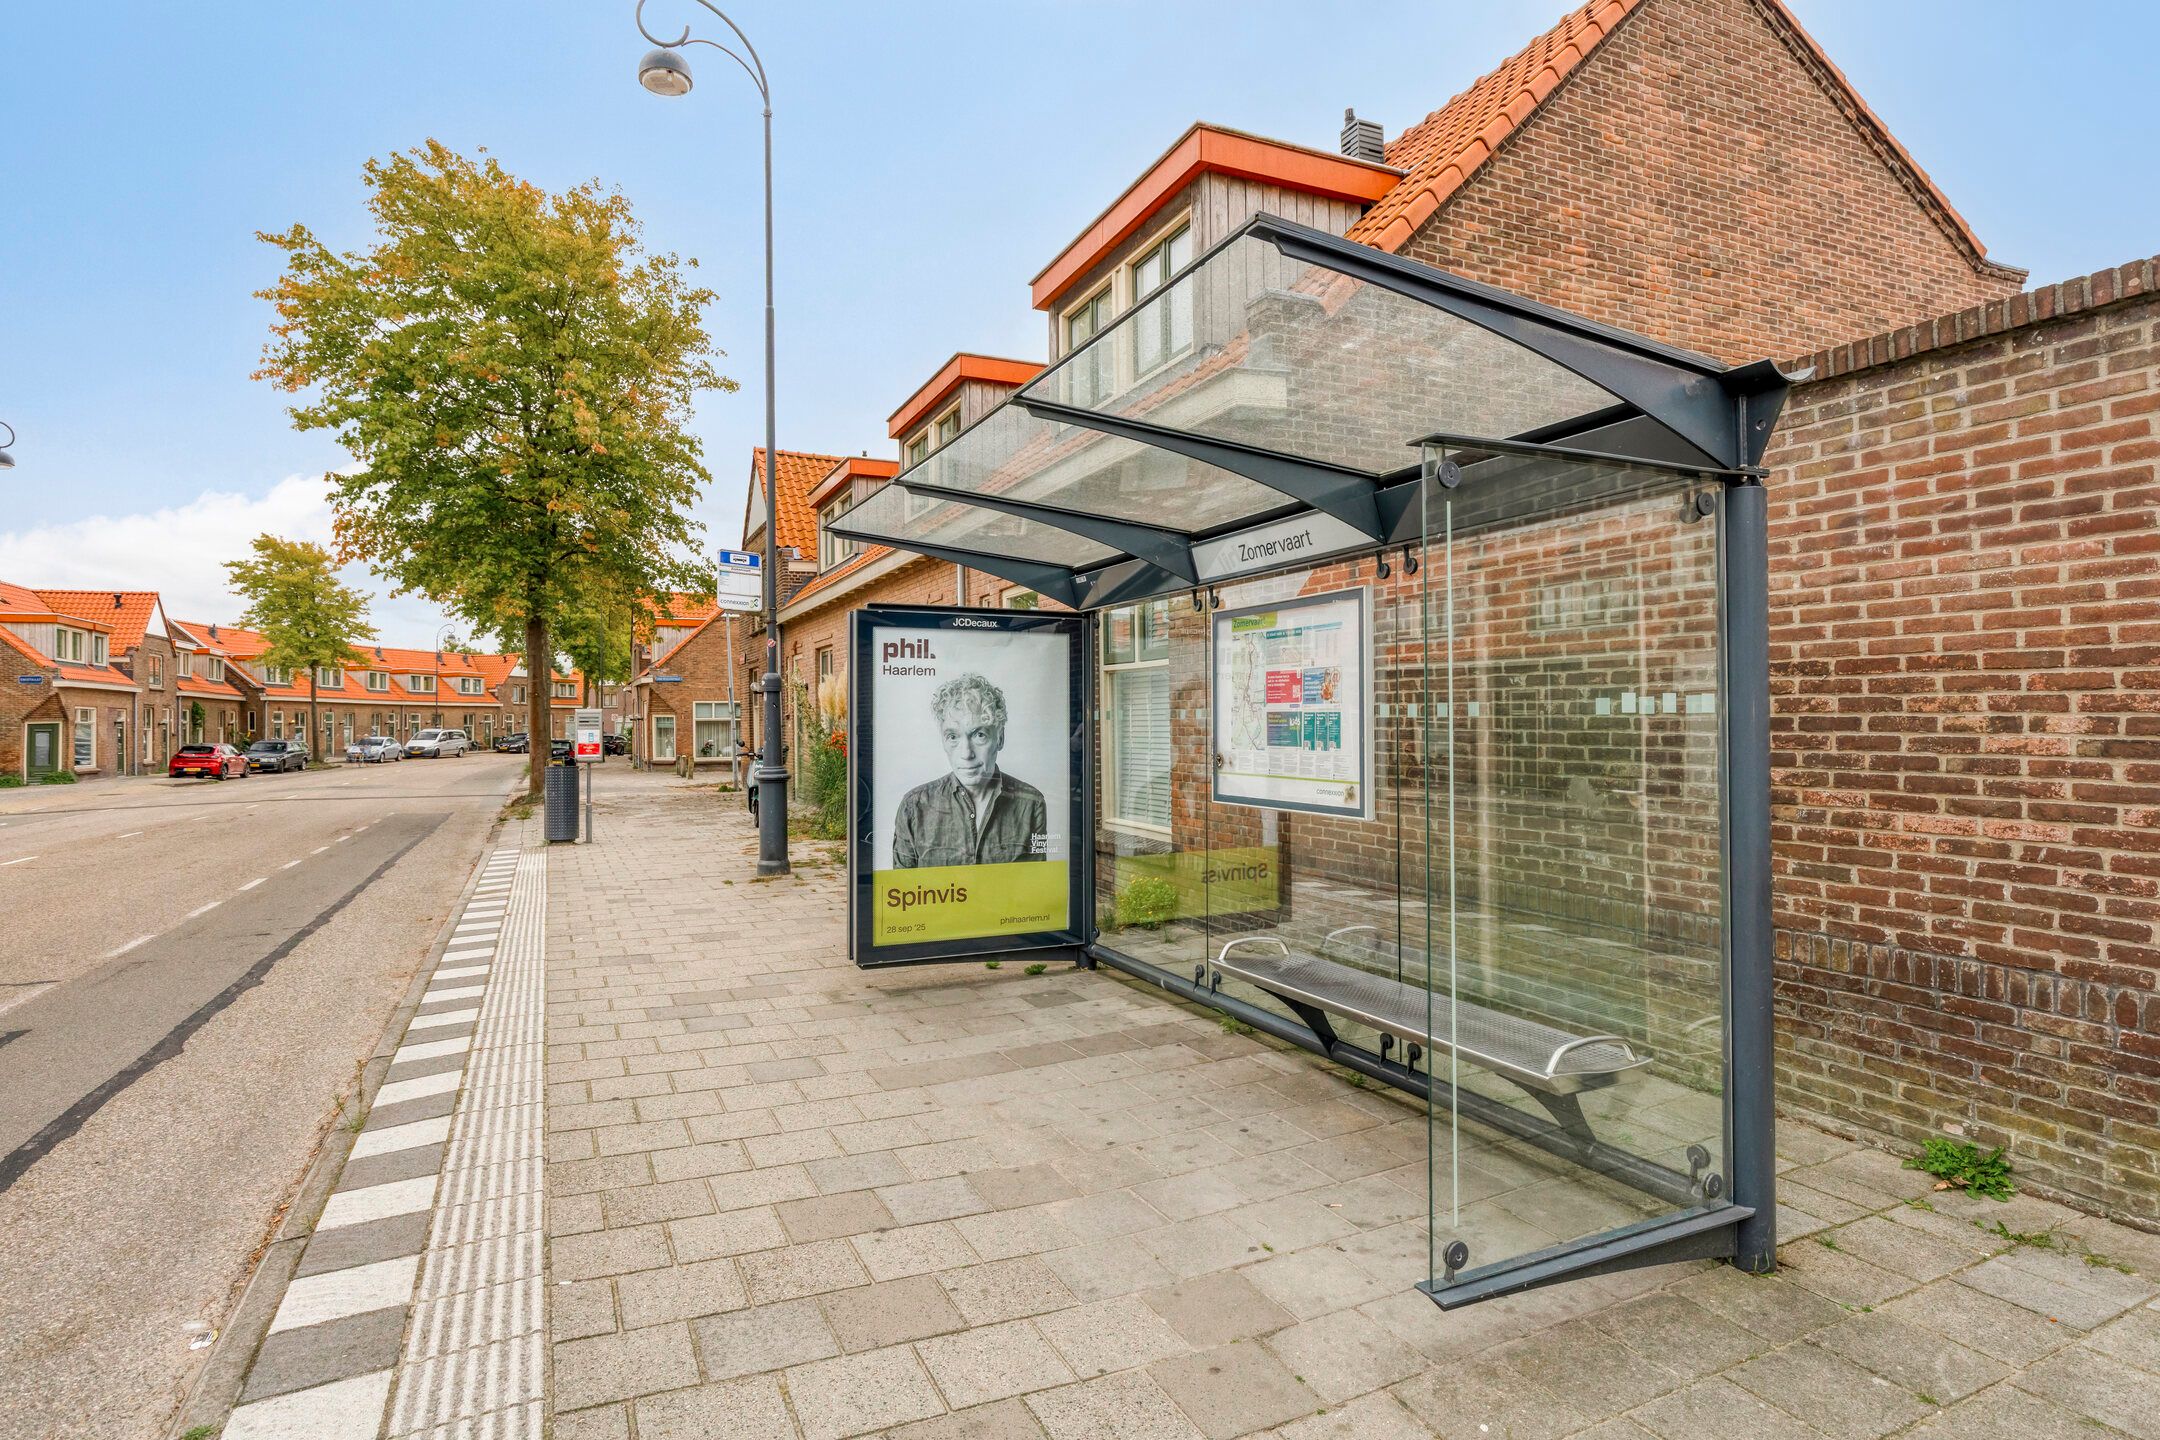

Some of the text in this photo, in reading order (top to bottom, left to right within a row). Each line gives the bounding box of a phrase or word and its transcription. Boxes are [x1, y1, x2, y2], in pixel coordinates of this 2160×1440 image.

[1238, 529, 1313, 562] Zomervaart
[952, 617, 998, 628] JCDecaux
[883, 638, 936, 663] phil.
[882, 664, 936, 677] Haarlem
[886, 883, 968, 912] Spinvis
[886, 925, 897, 934] 28
[897, 925, 913, 934] sep
